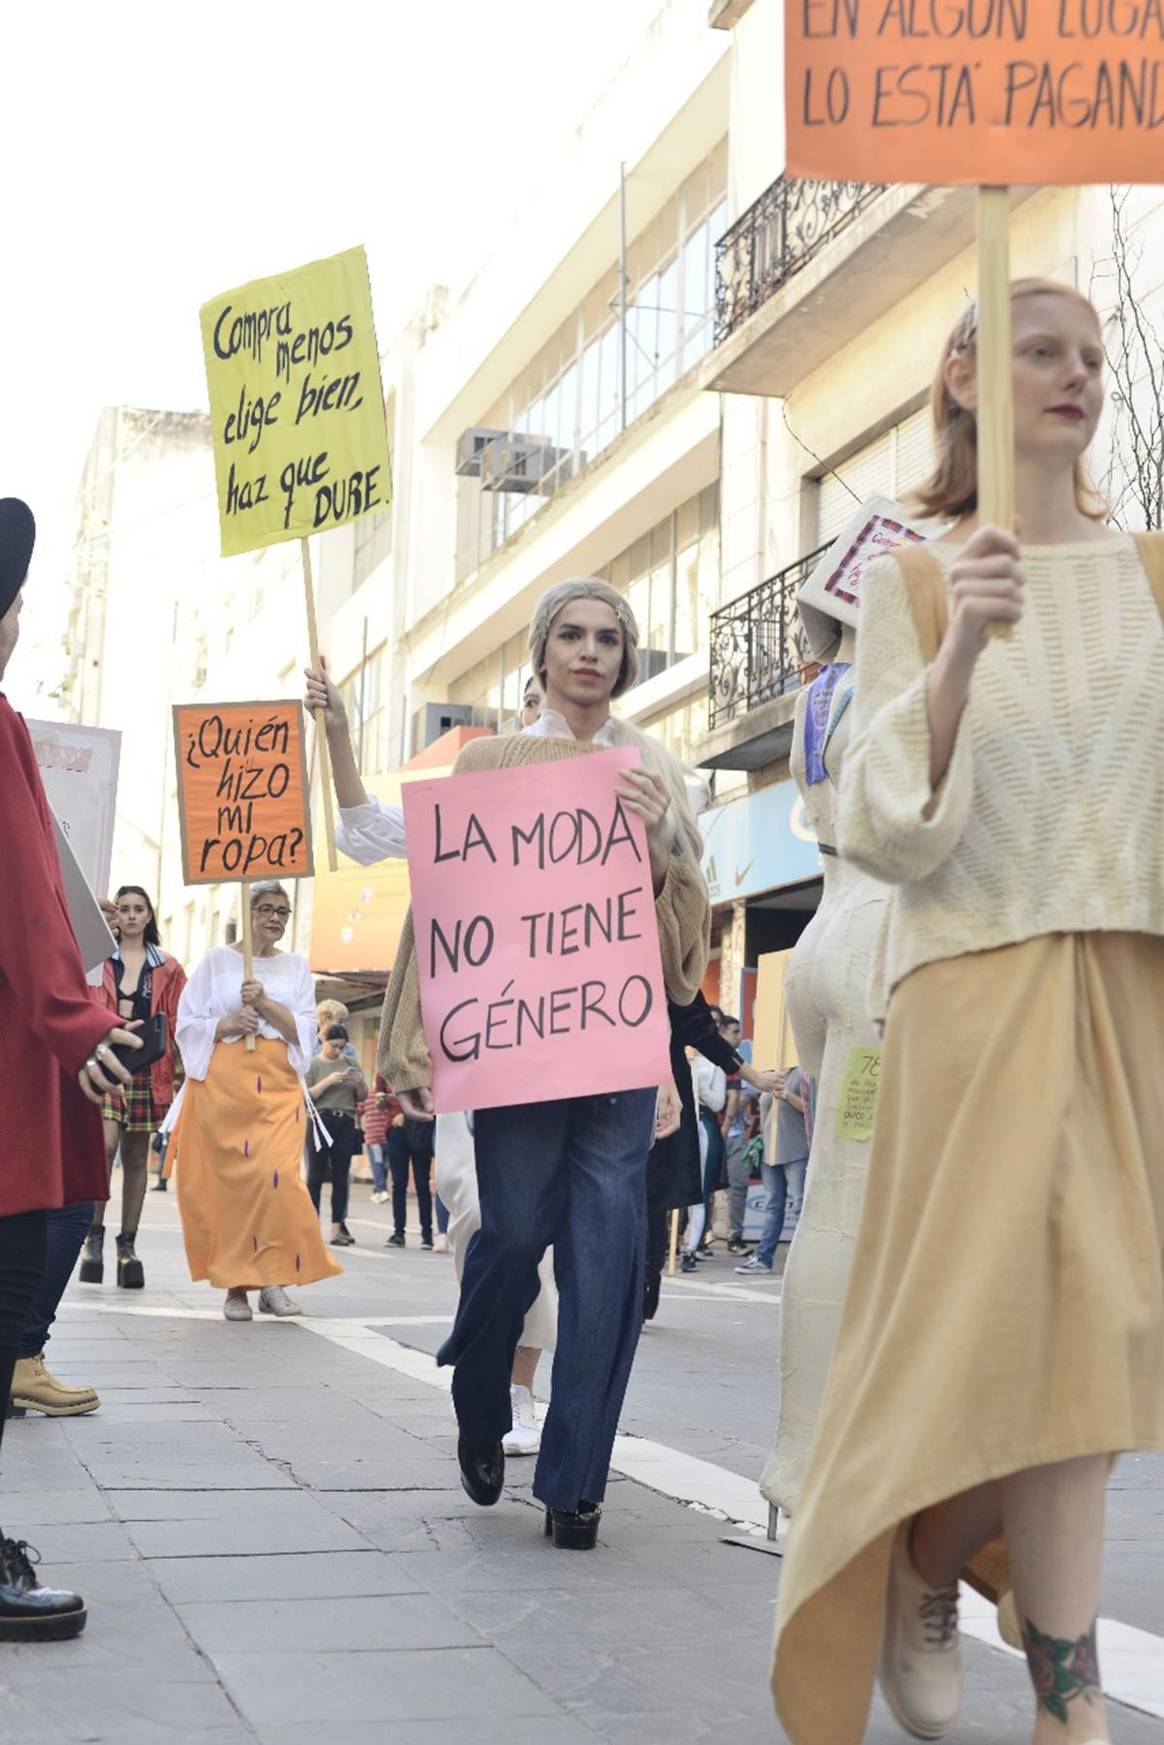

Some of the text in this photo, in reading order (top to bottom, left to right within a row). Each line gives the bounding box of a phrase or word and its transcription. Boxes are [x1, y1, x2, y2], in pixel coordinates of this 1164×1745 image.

[802, 0, 859, 39] EN
[803, 67, 850, 126] LO
[213, 301, 292, 363] Compra
[276, 314, 354, 384] menos
[224, 372, 364, 454] elige bien,
[226, 452, 329, 529] haz que
[312, 465, 390, 528] DURE.
[187, 715, 289, 768] ¿Quién
[200, 827, 303, 875] ropa?
[433, 797, 642, 870] LA MODA
[430, 887, 643, 979] NO TIENE
[439, 974, 654, 1062] GÉNERO
